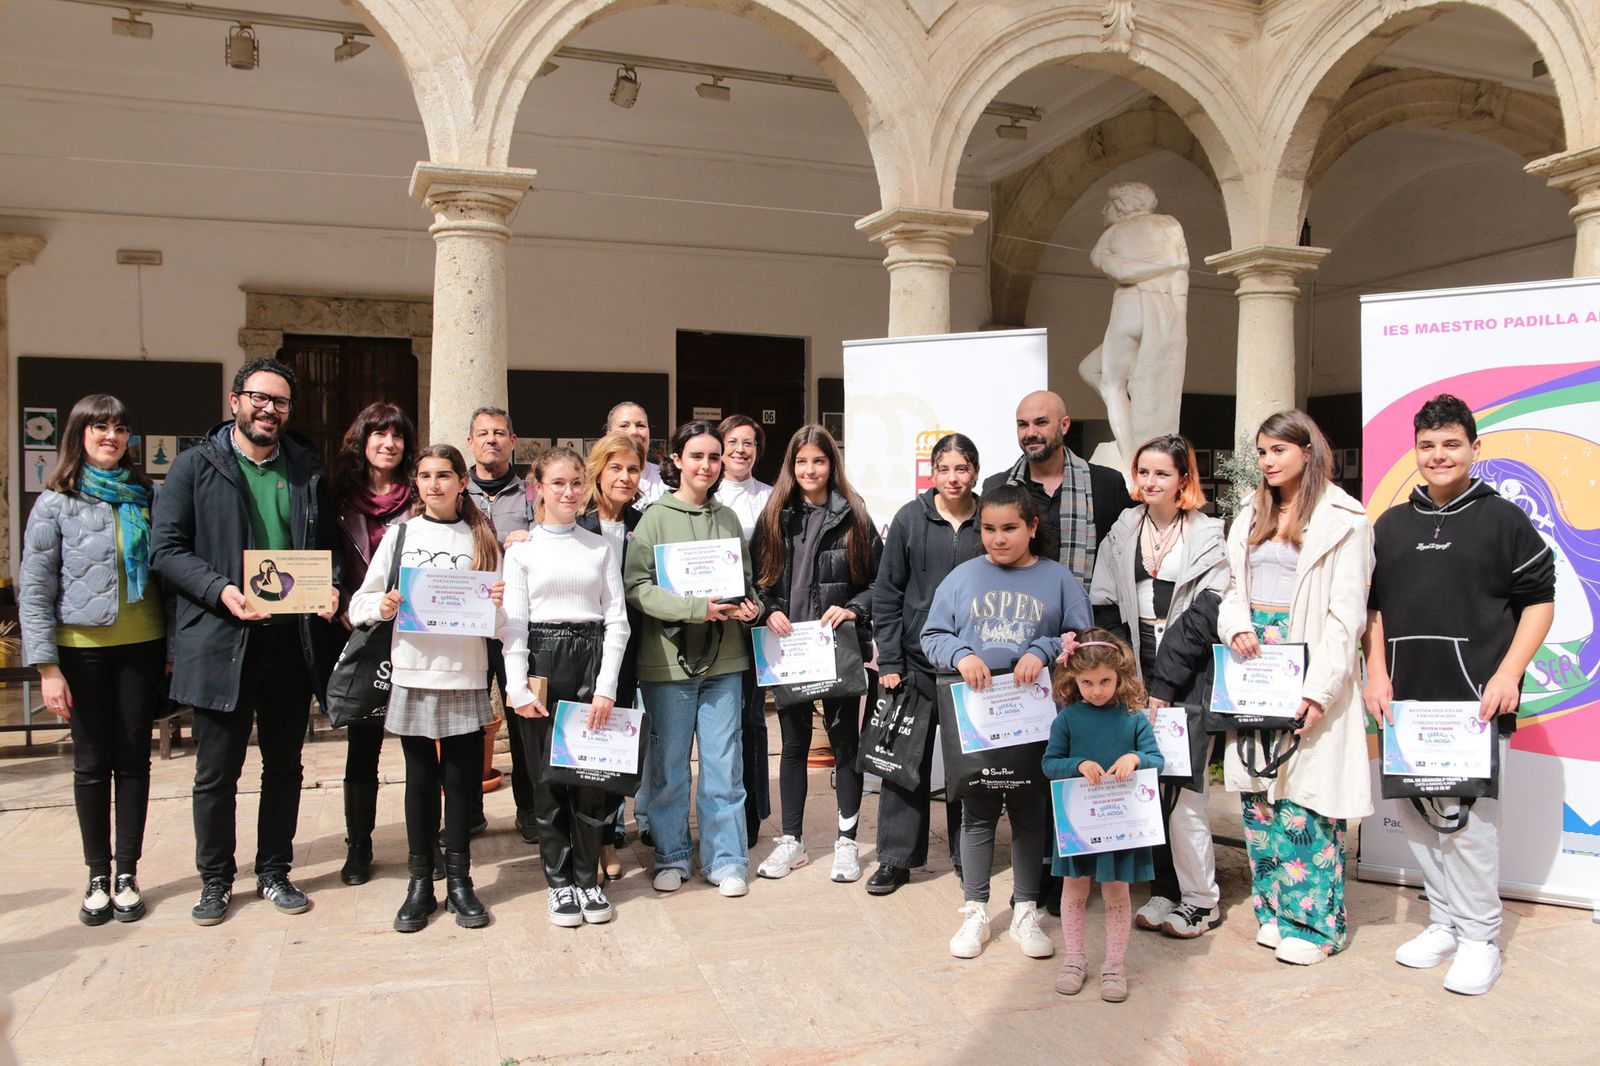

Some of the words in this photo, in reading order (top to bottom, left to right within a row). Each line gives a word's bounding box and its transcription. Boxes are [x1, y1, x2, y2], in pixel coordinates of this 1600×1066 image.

[1384, 324, 1409, 336] IES
[1415, 318, 1498, 334] MAESTRO
[1504, 313, 1578, 328] PADILLA
[764, 411, 774, 422] 06
[970, 590, 1044, 622] ASPEN
[1534, 654, 1582, 687] SER
